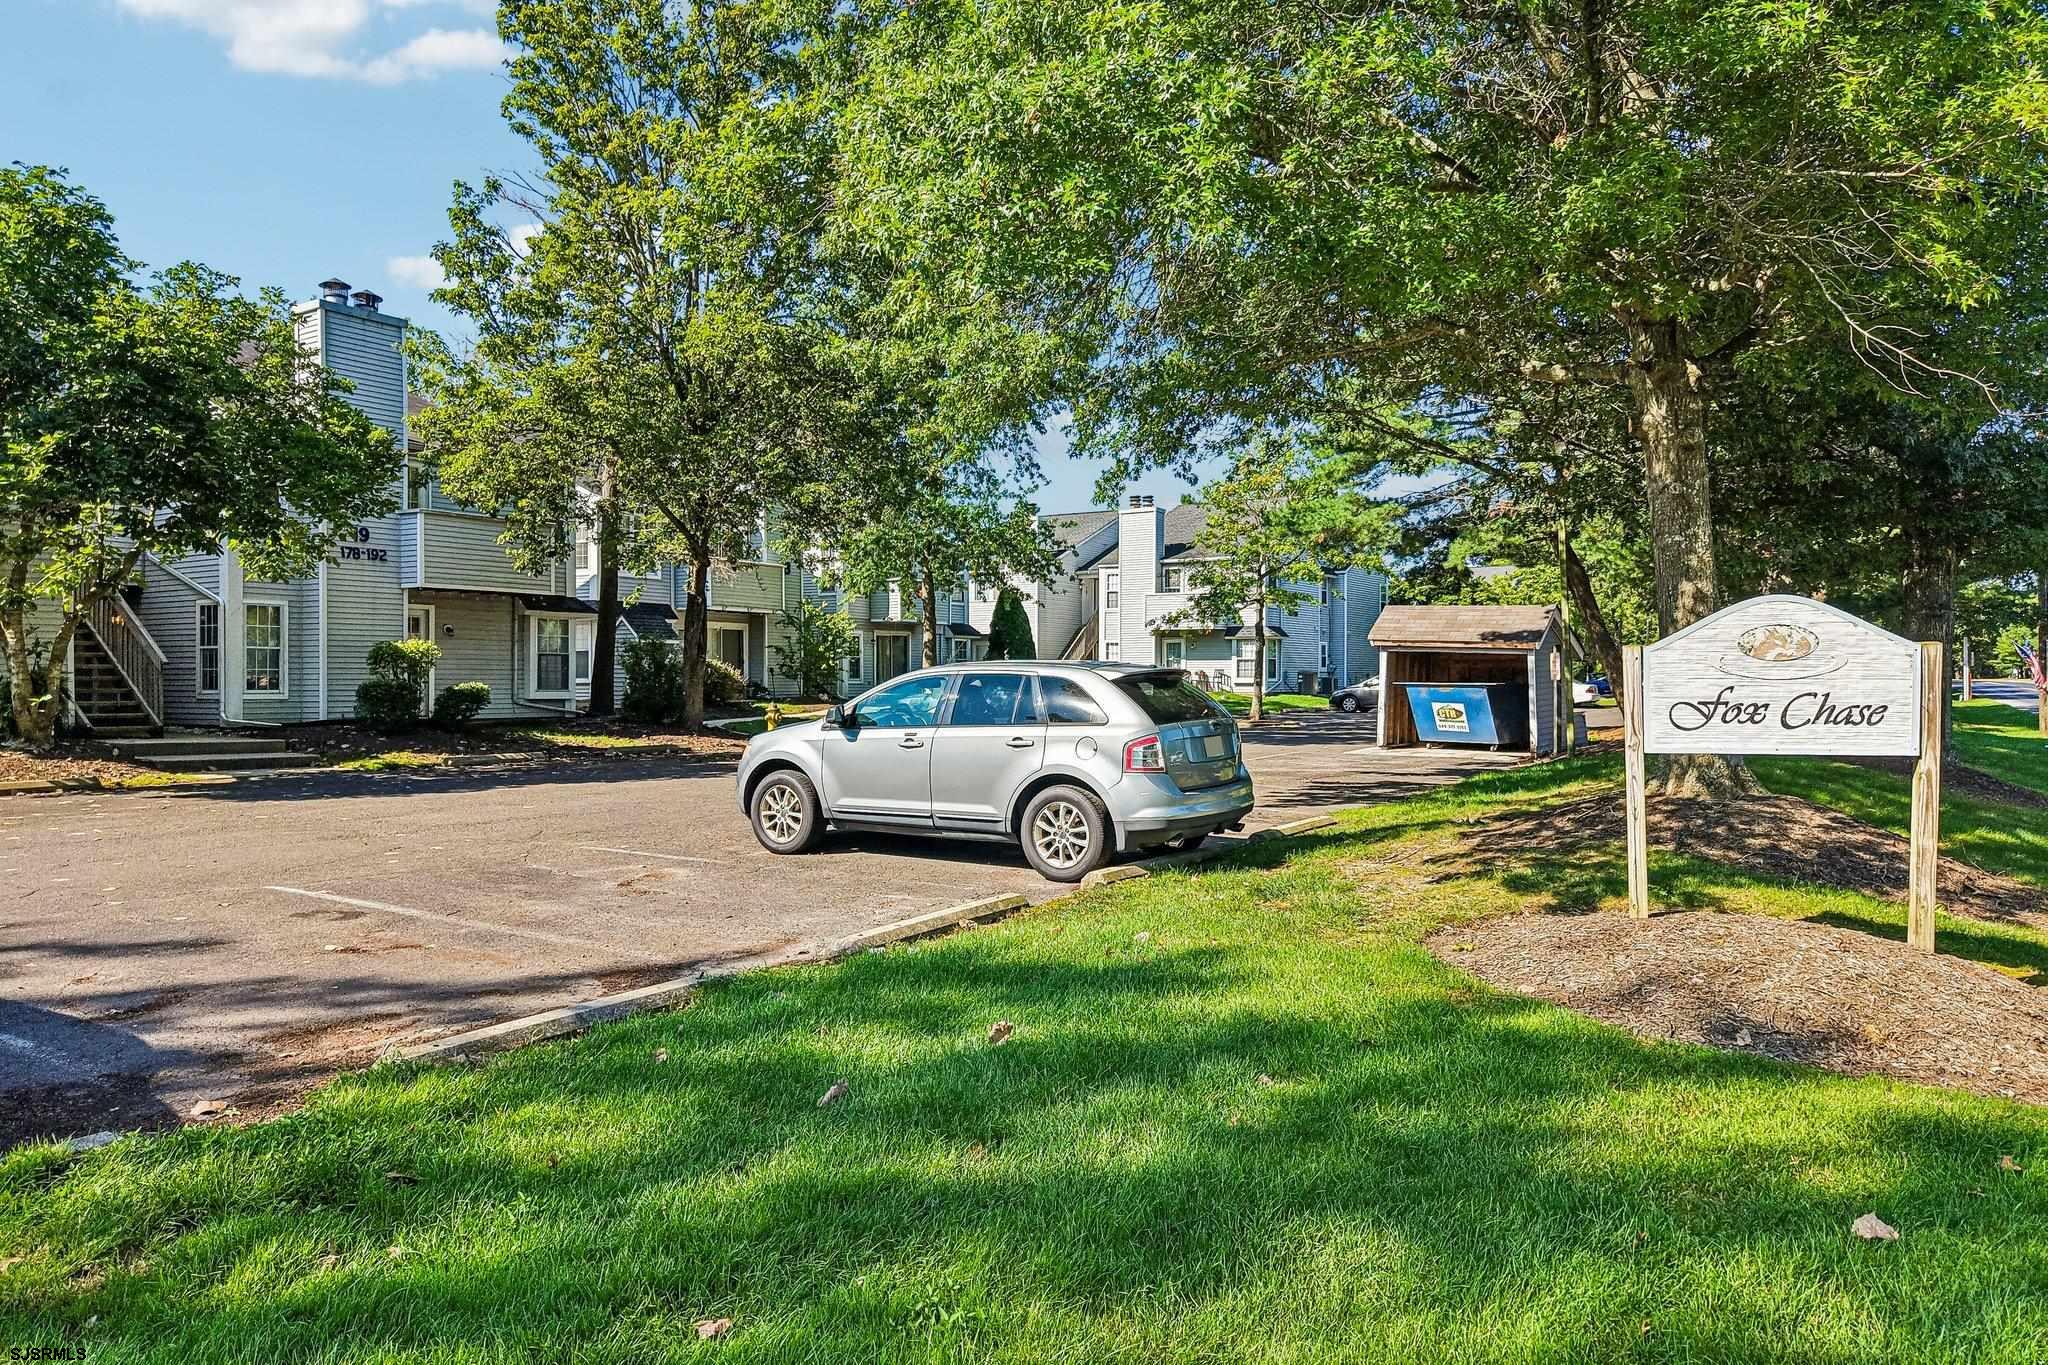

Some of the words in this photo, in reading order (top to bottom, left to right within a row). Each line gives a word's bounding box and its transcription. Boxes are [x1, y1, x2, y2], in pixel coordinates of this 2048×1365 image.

[340, 546, 388, 561] 178-192
[1669, 686, 1770, 731] Fox
[1780, 692, 1889, 730] Chase
